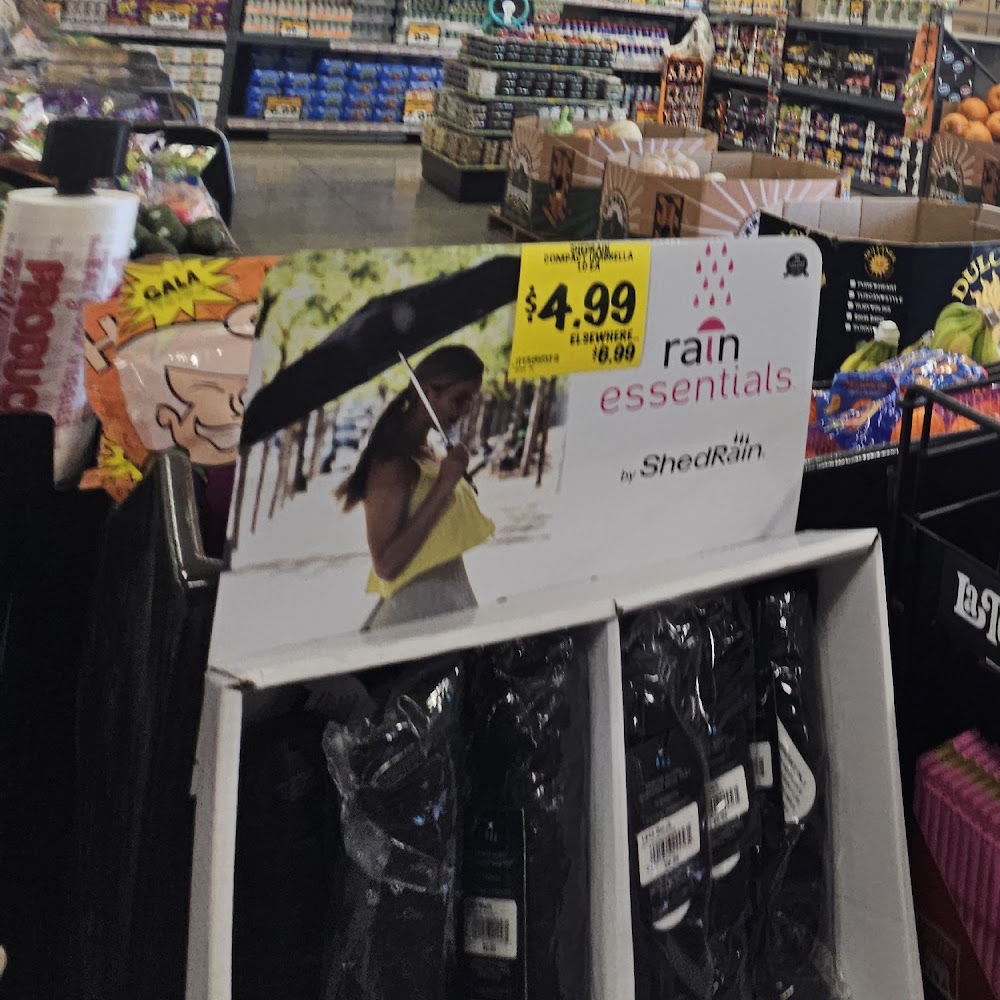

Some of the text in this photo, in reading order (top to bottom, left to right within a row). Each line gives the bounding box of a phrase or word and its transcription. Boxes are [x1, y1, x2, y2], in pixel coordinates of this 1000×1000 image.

[143, 269, 200, 300] GALA
[525, 280, 637, 331] $4.99
[663, 333, 741, 370] rain
[600, 361, 793, 414] essentials
[620, 469, 637, 485] by
[639, 438, 768, 479] ShedRain
[953, 570, 987, 630] La
